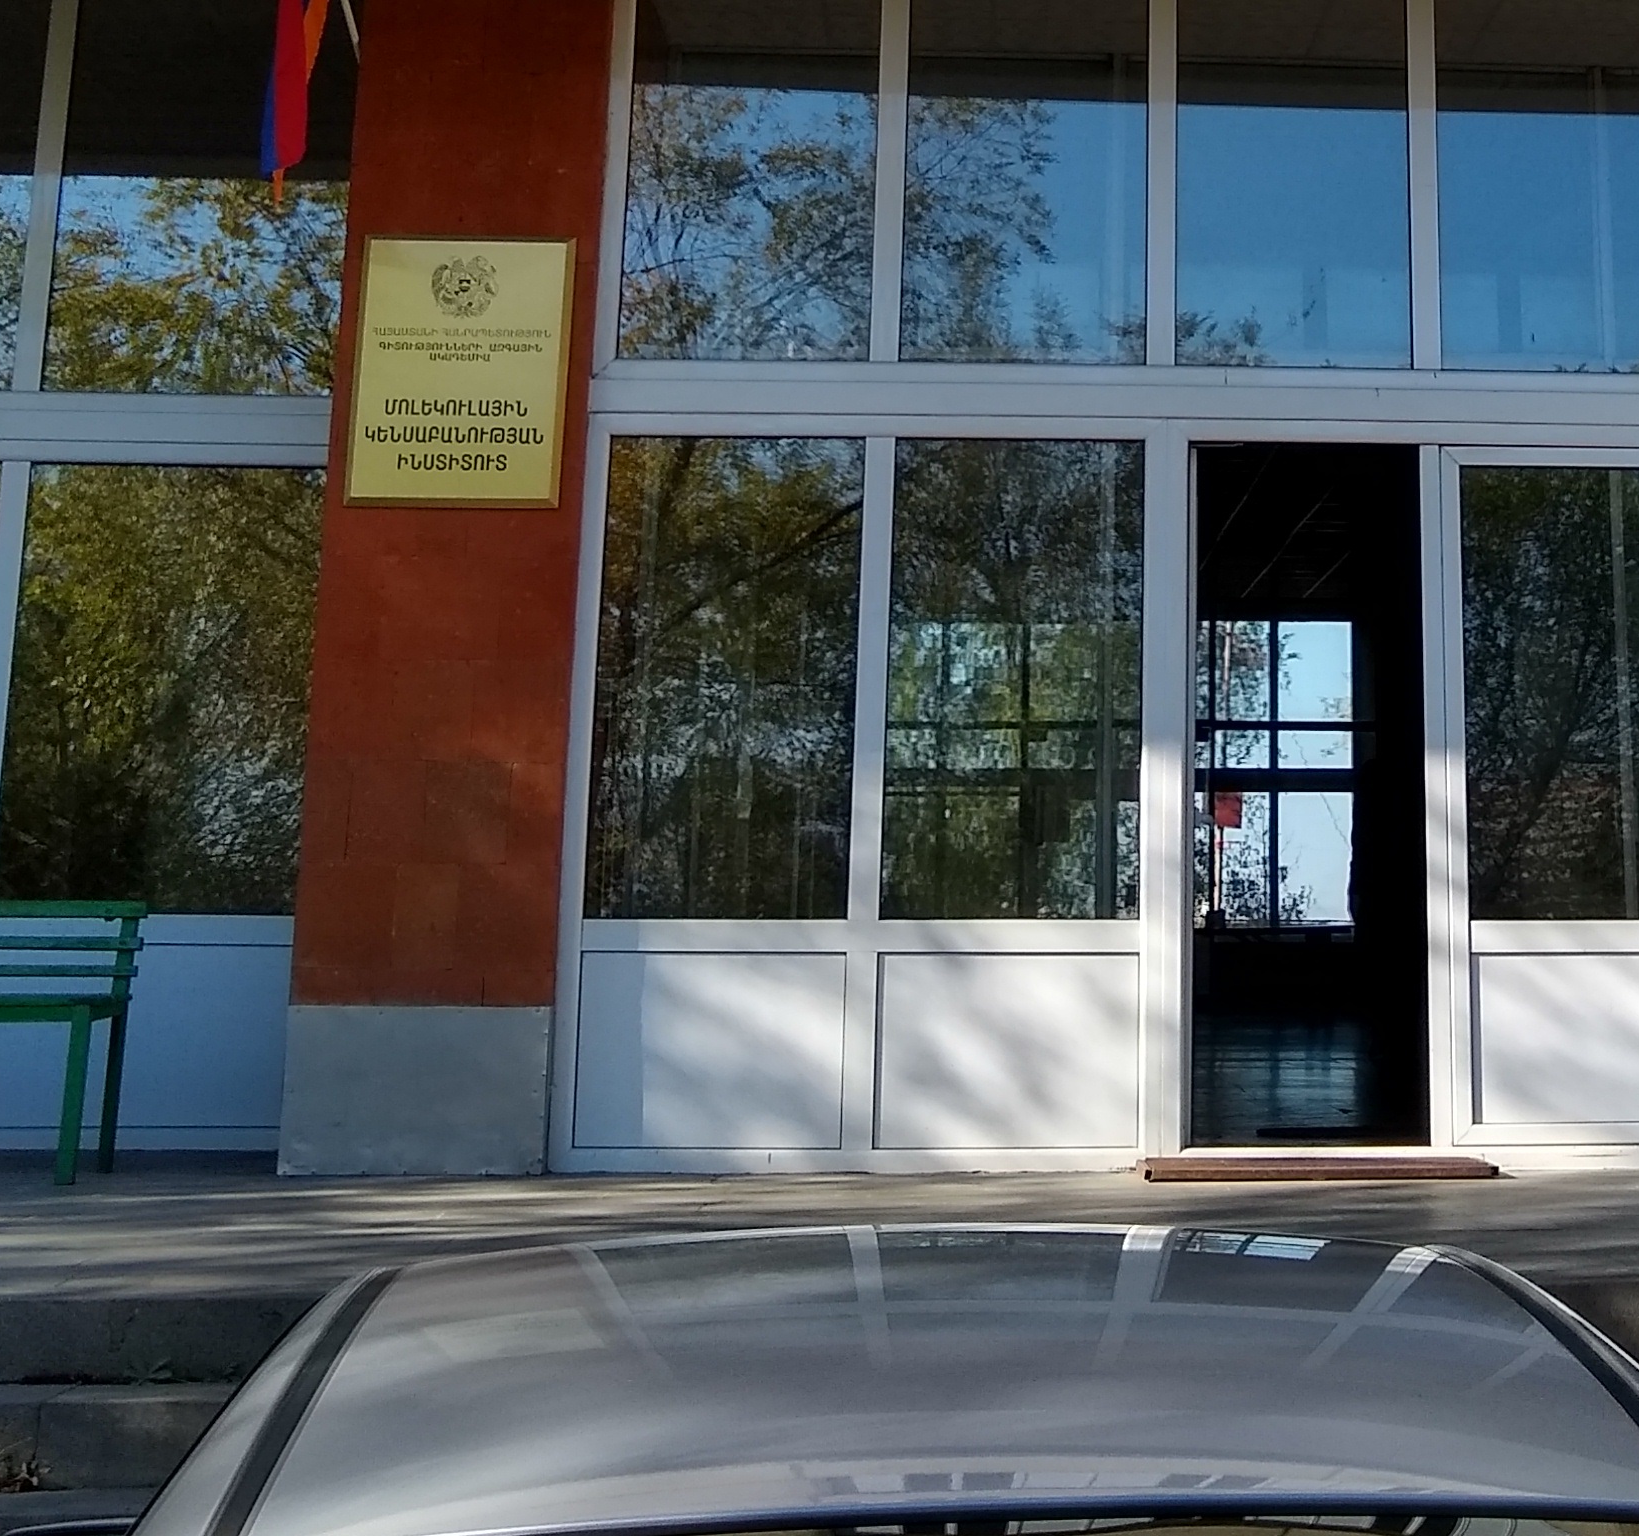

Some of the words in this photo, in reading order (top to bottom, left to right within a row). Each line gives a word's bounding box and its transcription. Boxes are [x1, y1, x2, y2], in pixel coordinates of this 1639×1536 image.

[385, 399, 527, 417] ՄՈԼԵԿՈՒԼԱՅԻՆ
[365, 426, 544, 444] ԿԵՆՍԱԲԱՆՈՒԹՅԱՆ
[397, 453, 508, 471] ԻՆՍՏԻՏՈՒՏ
